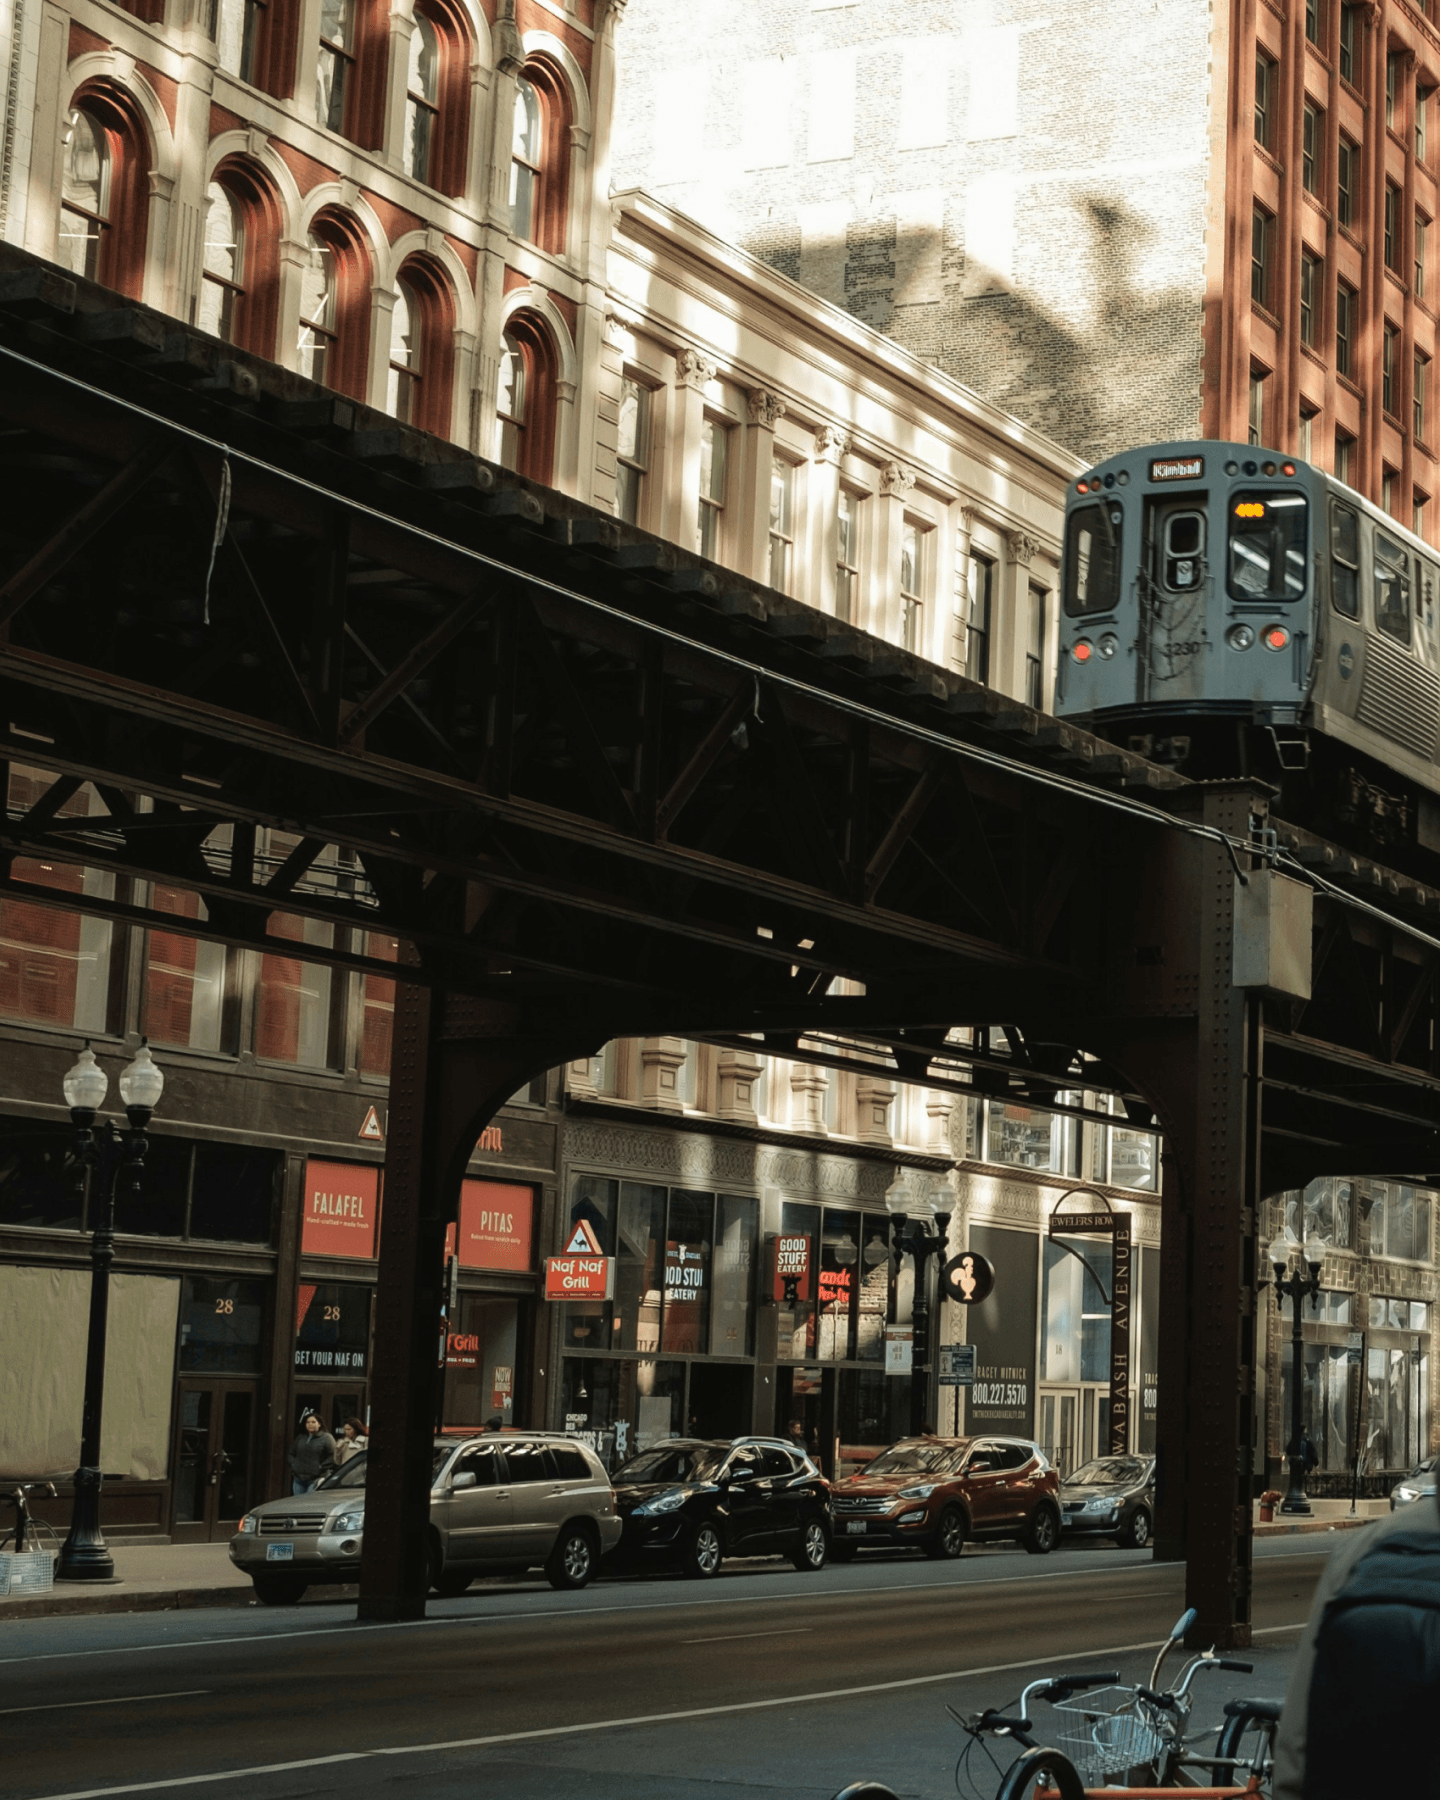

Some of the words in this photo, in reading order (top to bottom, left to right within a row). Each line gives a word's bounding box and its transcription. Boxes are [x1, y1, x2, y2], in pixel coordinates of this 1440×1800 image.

[312, 1191, 364, 1218] FALAFEL
[480, 1210, 513, 1233] PITAS
[1051, 1216, 1093, 1227] EWELERS
[779, 1238, 806, 1251] GOOD
[778, 1252, 808, 1265] STUFF
[551, 1260, 576, 1275] Naf
[578, 1260, 604, 1275] Naf
[777, 1265, 807, 1273] EATERY
[562, 1276, 590, 1289] Grill
[1115, 1229, 1130, 1330] AVENUE
[669, 1287, 697, 1301] EATERY
[215, 1298, 234, 1314] 28
[323, 1305, 341, 1321] 28
[454, 1334, 479, 1351] Grill
[295, 1350, 310, 1365] GET
[312, 1351, 333, 1366] YOUR
[334, 1352, 350, 1367] NAF
[352, 1353, 364, 1367] ON
[495, 1367, 512, 1382] NOW
[977, 1366, 998, 1380] RACEY
[972, 1383, 1027, 1406] 800.227.5570
[1113, 1353, 1128, 1455] WABASH
